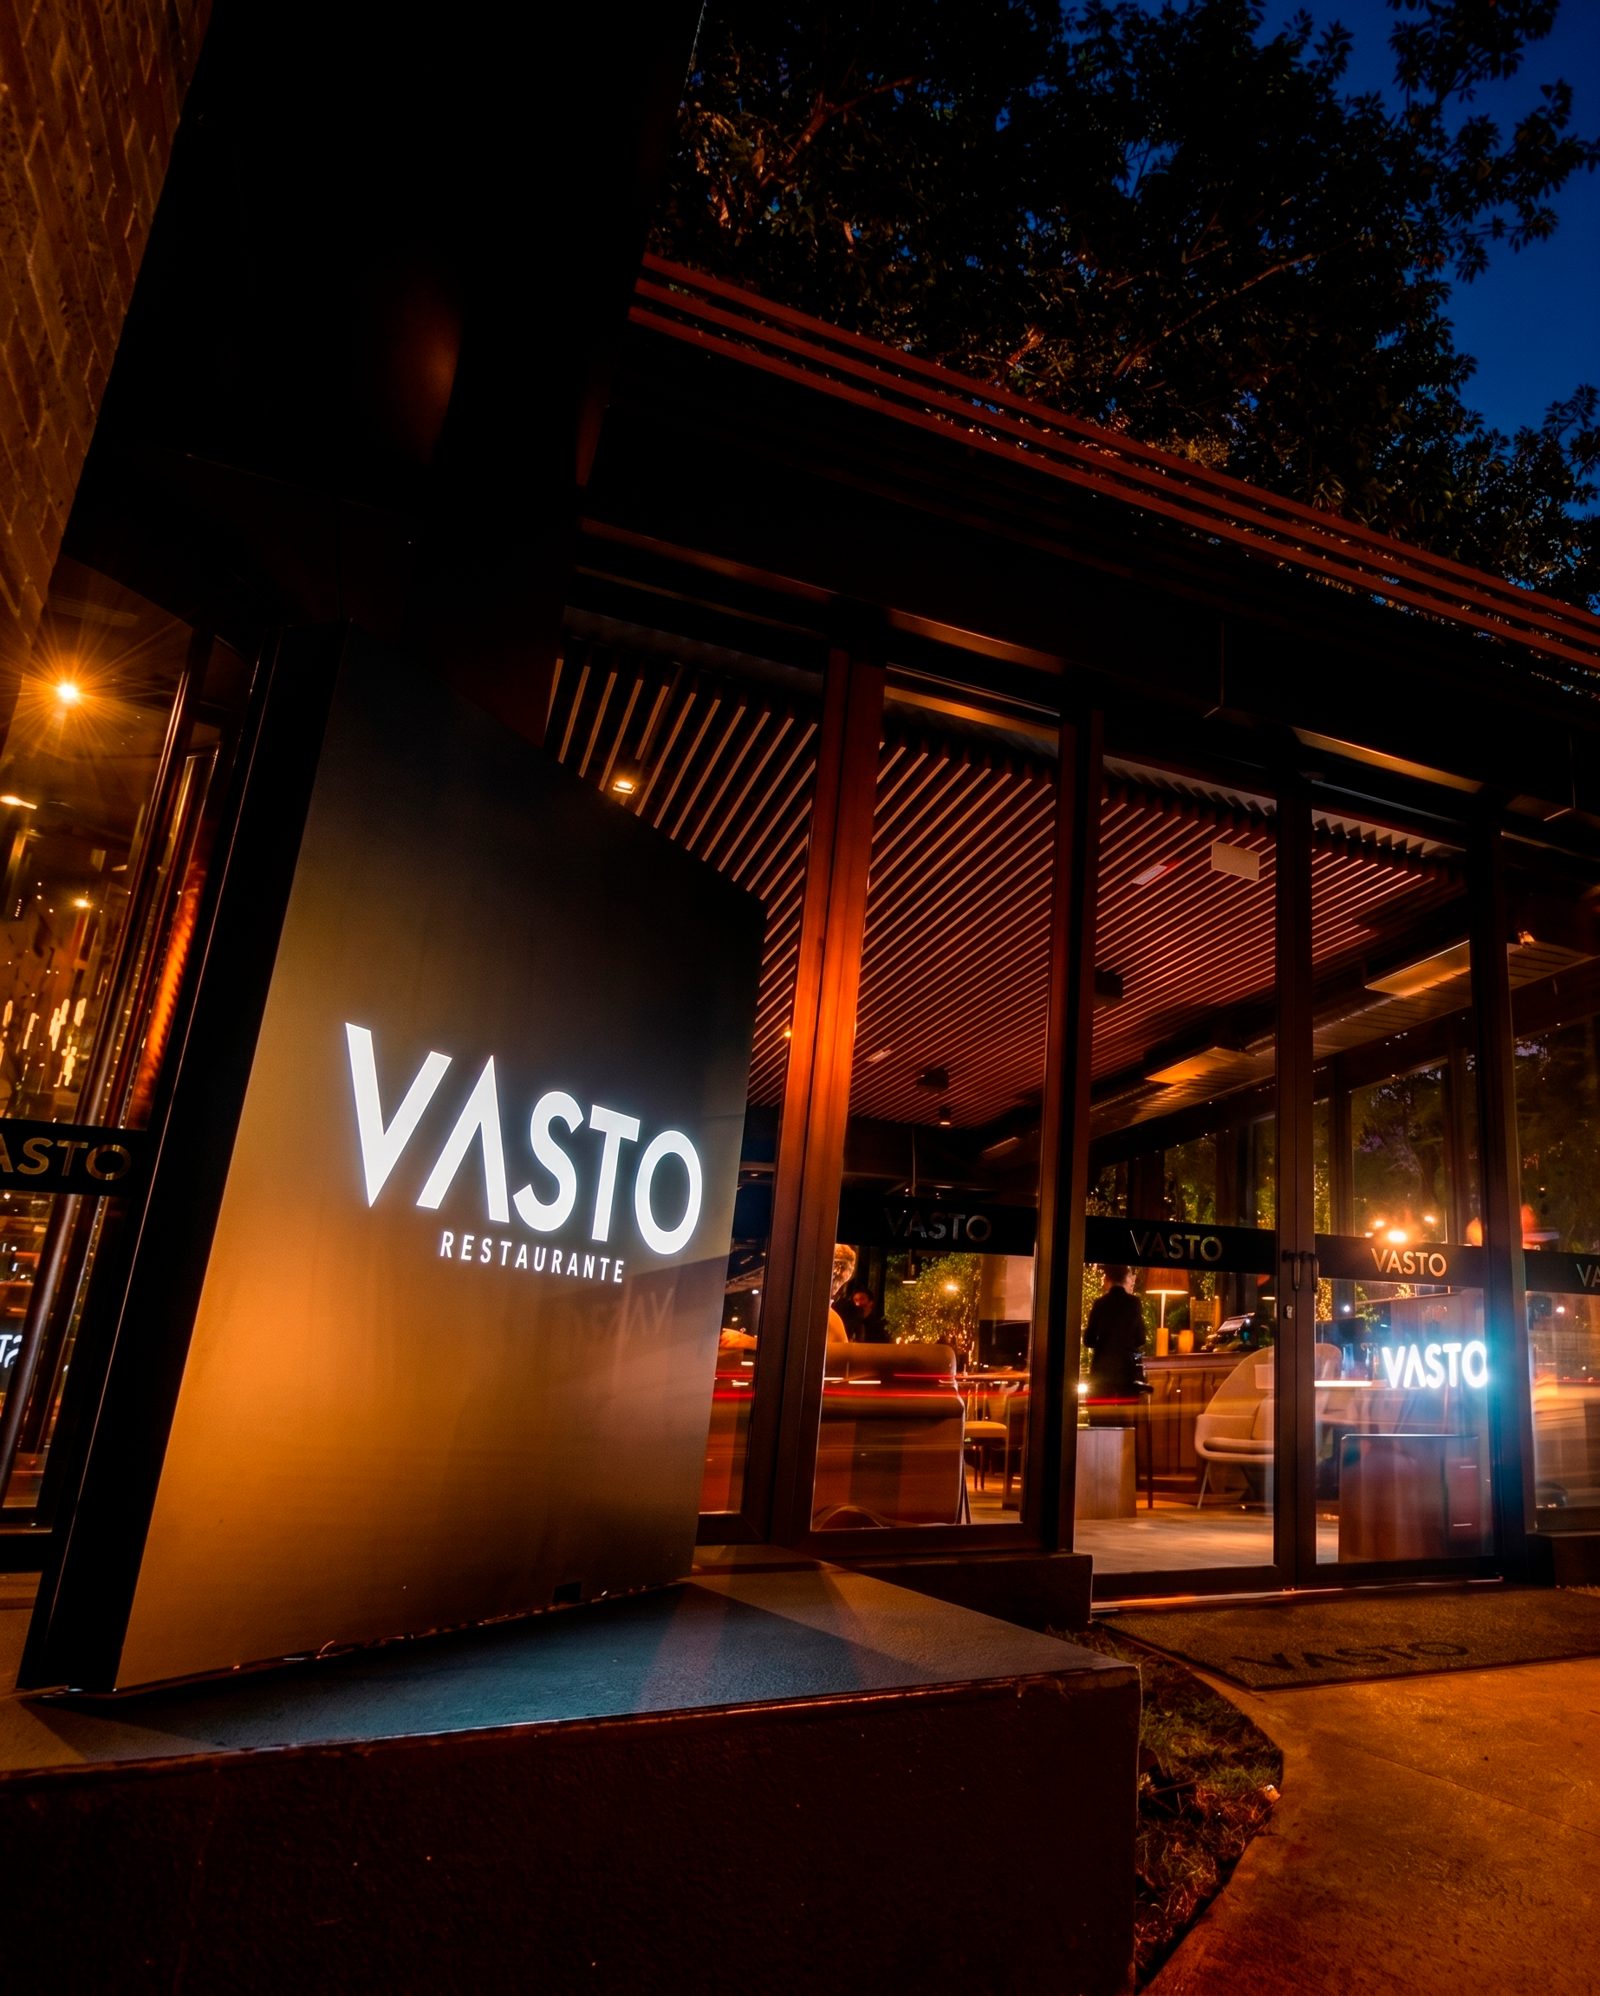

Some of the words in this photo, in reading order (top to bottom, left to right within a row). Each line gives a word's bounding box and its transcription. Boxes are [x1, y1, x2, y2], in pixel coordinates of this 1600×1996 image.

[345, 1022, 702, 1254] VASTO
[883, 1207, 993, 1242] VASTO
[440, 1231, 625, 1283] RESTAURANTE
[1129, 1230, 1223, 1262] VASTO
[1371, 1248, 1447, 1277] VASTO
[1381, 1341, 1488, 1389] VASTO
[1231, 1641, 1468, 1670] VASTO
